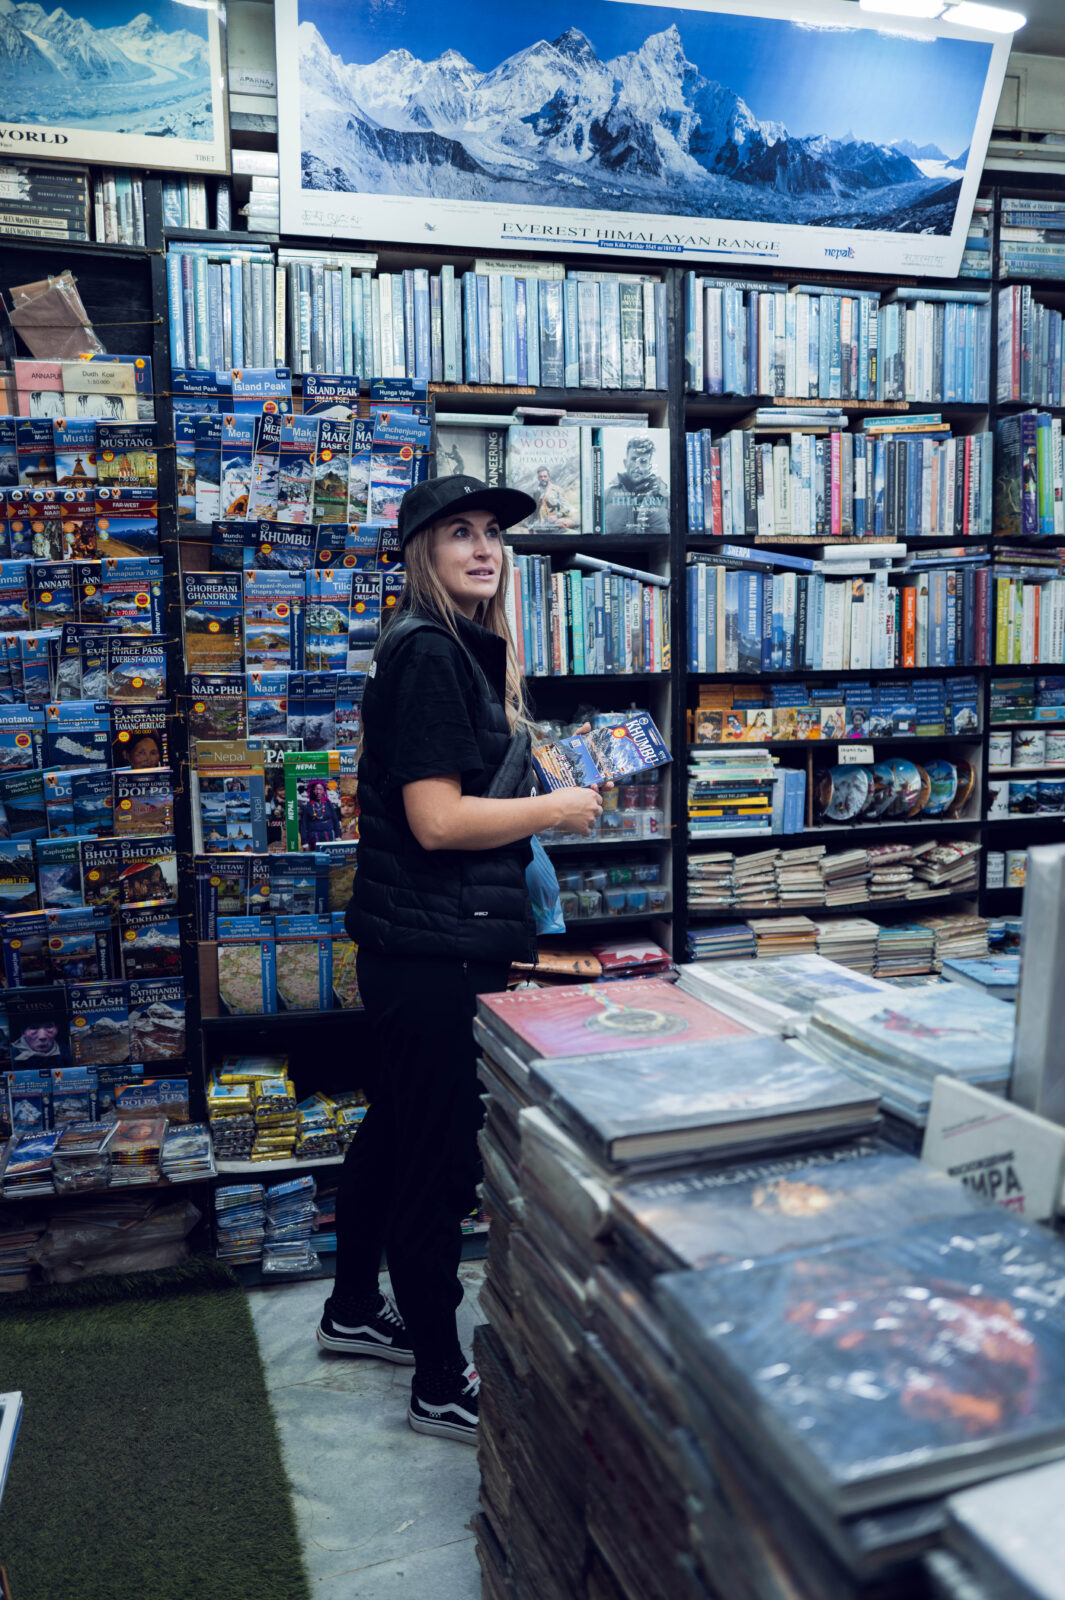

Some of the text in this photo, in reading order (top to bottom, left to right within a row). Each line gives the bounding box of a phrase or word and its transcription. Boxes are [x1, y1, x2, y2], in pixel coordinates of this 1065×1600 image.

[195, 154, 216, 163] TIBET
[502, 222, 782, 252] EVEREST HIMALAYAN RANGE
[201, 385, 218, 393] Peak
[234, 382, 287, 392] Island Peak
[306, 385, 358, 397] ISLAND PEAK
[397, 389, 416, 398] Valley
[228, 429, 251, 439] Mera
[376, 426, 426, 438] Kanchenjunga
[100, 438, 153, 448] MUSTANG
[401, 435, 416, 443] Camp
[520, 438, 569, 449] WOOD
[320, 441, 343, 450] BASE
[816, 442, 824, 456] K2
[703, 469, 711, 485] K2
[259, 530, 311, 547] KHUMBU
[726, 545, 751, 559] SHERPA
[106, 570, 145, 578] Annapurna
[186, 584, 238, 593] GHOREPANI
[187, 592, 238, 601] GHANDRUK
[947, 607, 955, 645] BEN FOGLE
[112, 646, 164, 656] THREE PASS
[112, 655, 164, 664] EVEREST GOKYO
[192, 686, 243, 695] NAR PHU
[255, 684, 278, 693] Naar
[114, 714, 166, 724] LANGTANG
[115, 721, 166, 731] TAMANG HERITAGE
[626, 719, 659, 764] KHUMBU
[214, 751, 246, 762] Nepal
[118, 787, 171, 798] DOLPO
[254, 796, 263, 823] Nepal
[121, 847, 172, 859] BHUTAN
[125, 914, 170, 924] POKHARA
[130, 987, 181, 997] KATHMANDU
[71, 998, 124, 1009] KAILASH
[138, 993, 181, 1004] KAILASH
